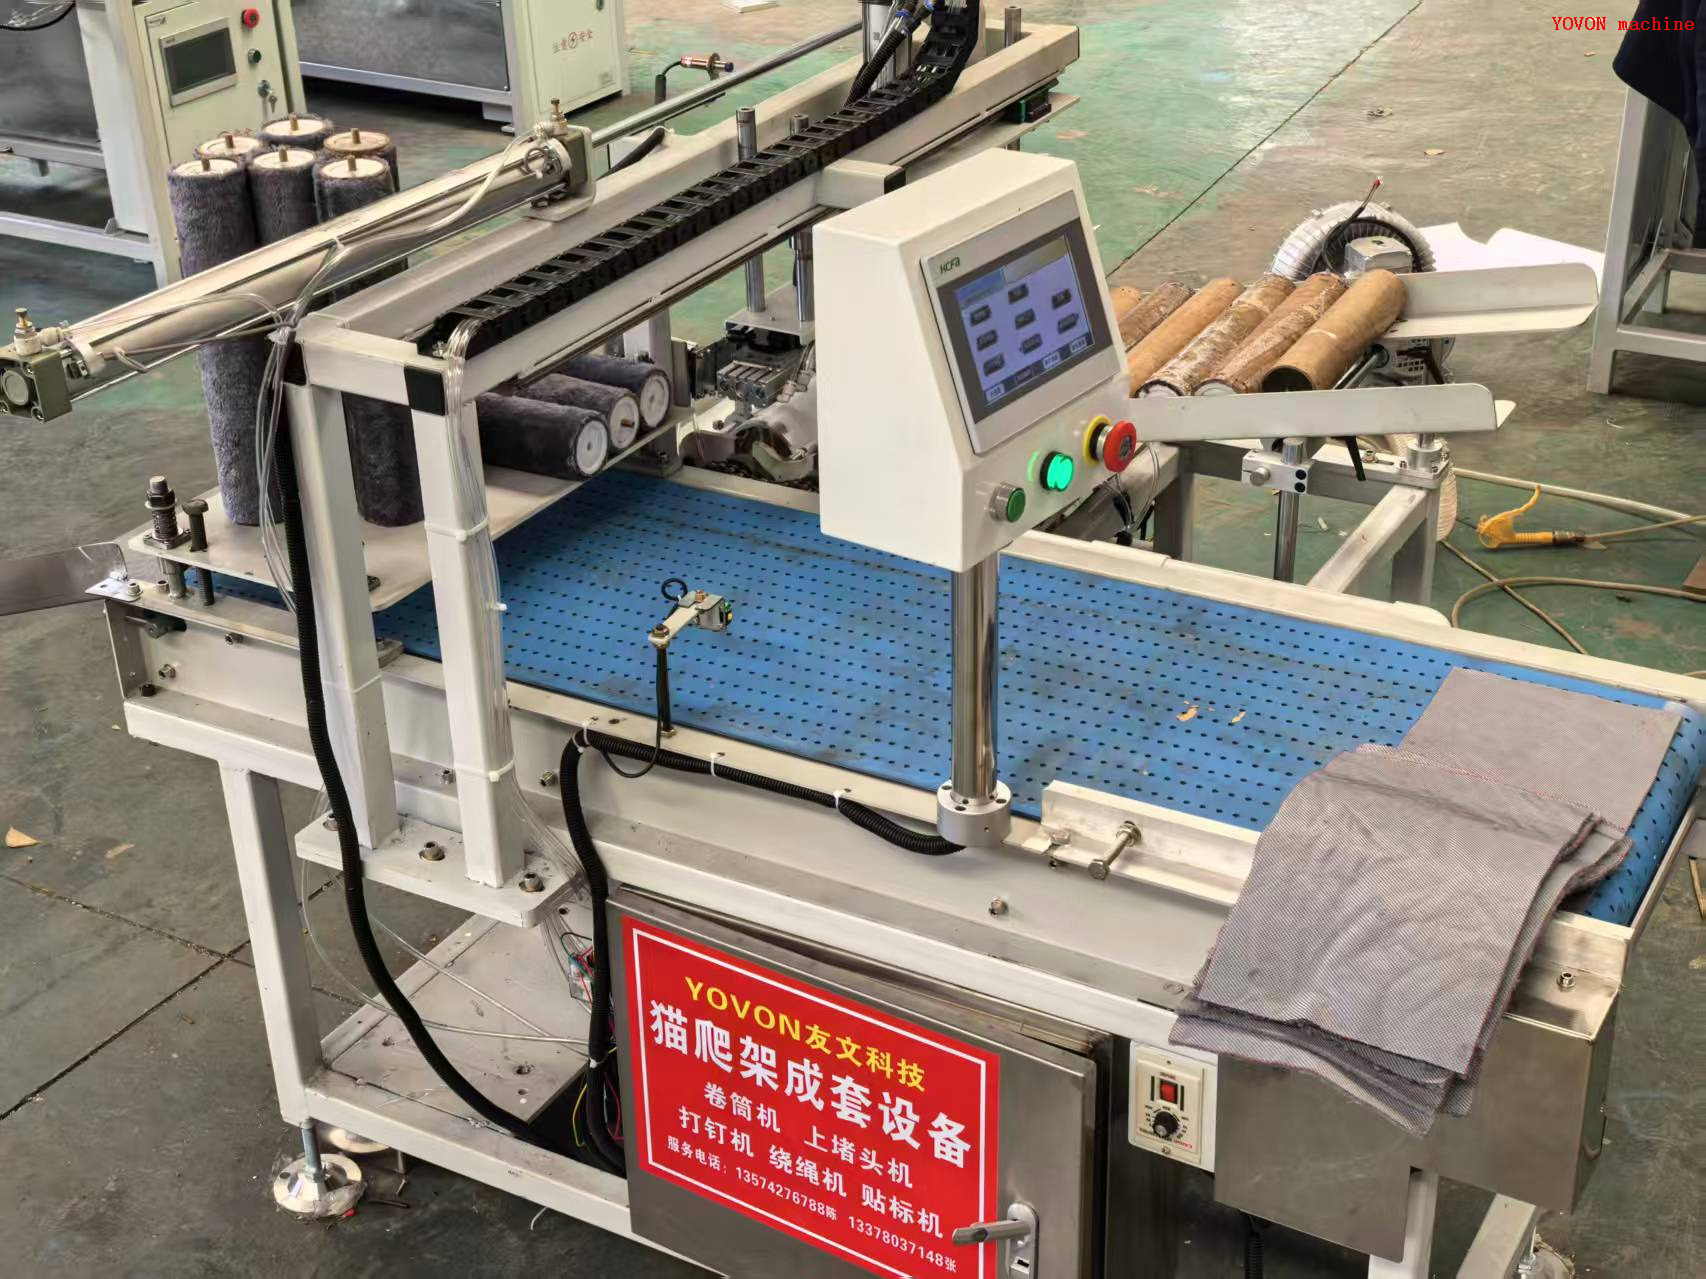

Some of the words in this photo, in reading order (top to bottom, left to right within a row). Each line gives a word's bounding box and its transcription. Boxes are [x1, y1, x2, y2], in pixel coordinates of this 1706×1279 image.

[650, 1000, 971, 1168] 猫爬架成套设备
[704, 1082, 781, 1133] 卷筒机
[804, 1126, 913, 1188] 上堵头机
[679, 1106, 754, 1157] 打钉机
[769, 1145, 847, 1197] 绕绳机
[862, 1184, 943, 1238] 贴标机
